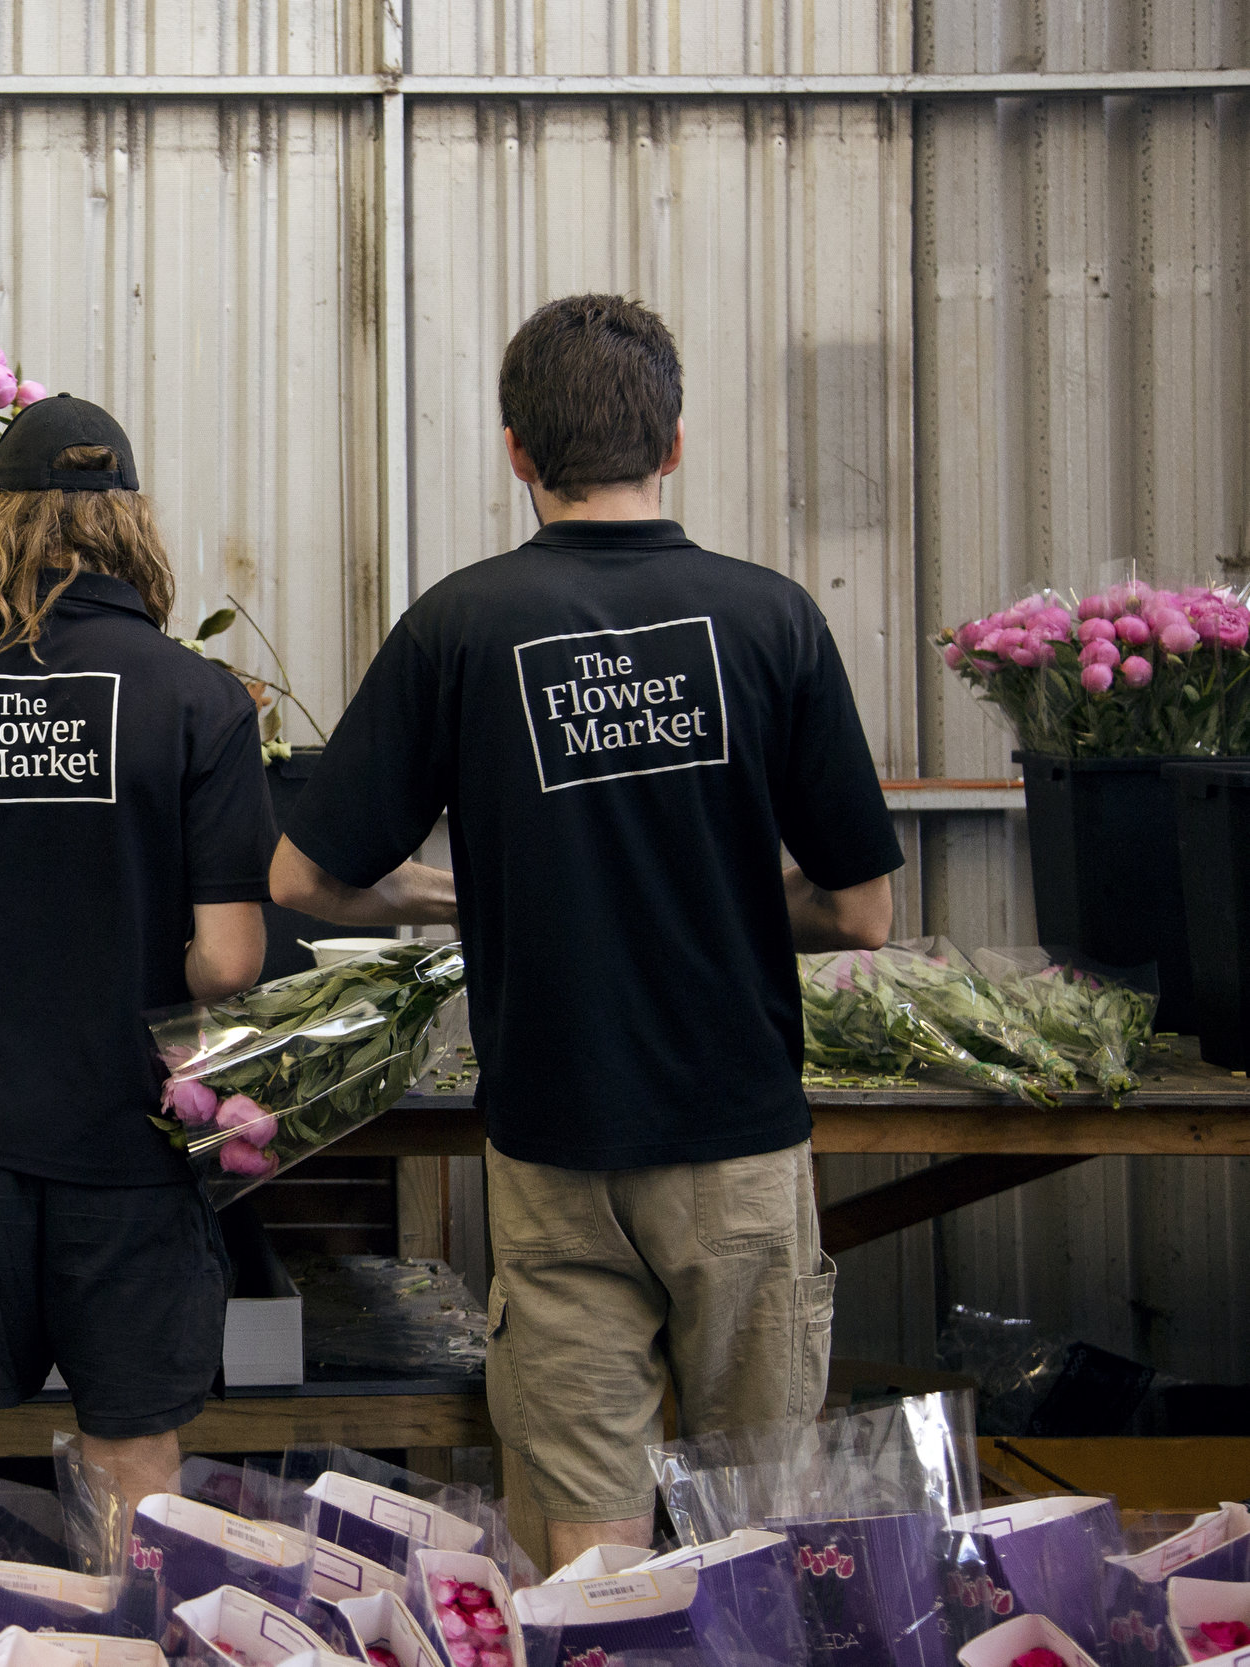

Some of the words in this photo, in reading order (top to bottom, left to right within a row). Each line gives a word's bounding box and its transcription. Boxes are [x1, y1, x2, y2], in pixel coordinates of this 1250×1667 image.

[574, 652, 633, 680] The
[542, 673, 686, 720] Flower
[560, 706, 708, 757] Market
